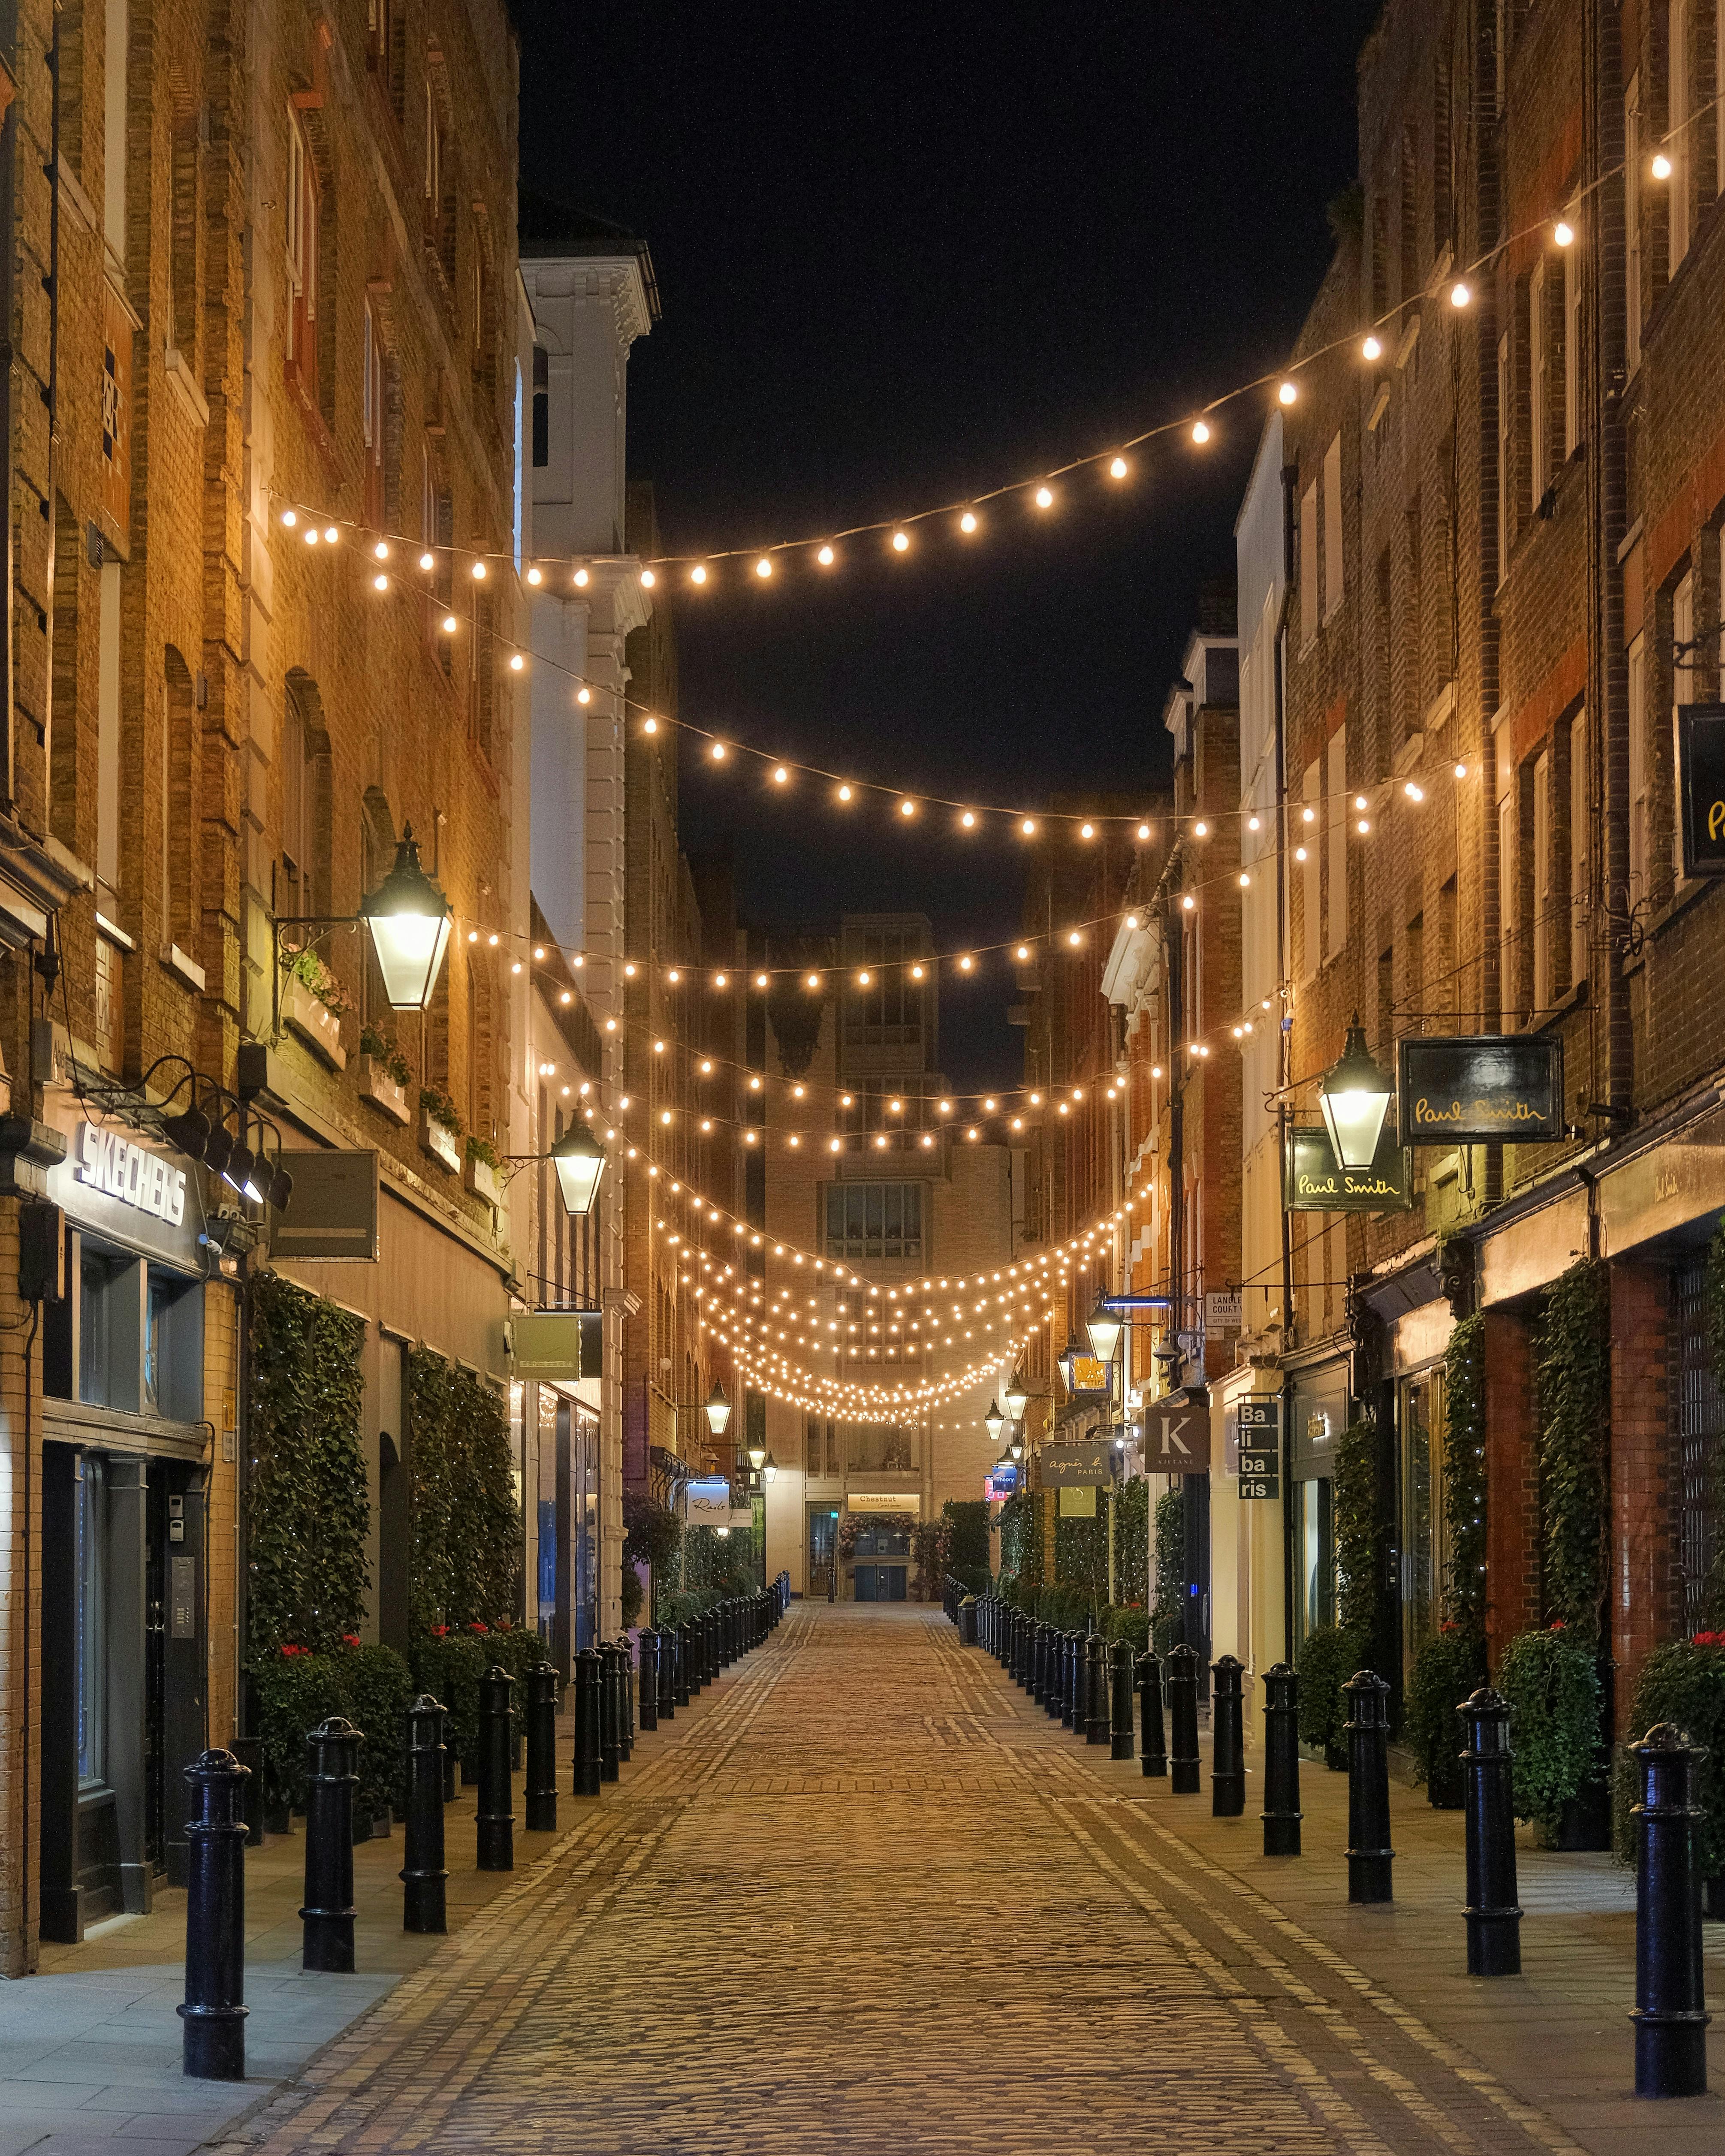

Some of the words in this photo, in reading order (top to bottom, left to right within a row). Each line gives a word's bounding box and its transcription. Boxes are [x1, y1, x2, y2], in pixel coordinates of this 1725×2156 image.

[1708, 800, 1725, 841] P
[1416, 1098, 1466, 1123] Paul
[1475, 1100, 1547, 1120] Smith
[81, 1120, 187, 1226] SKECHERS
[1299, 1174, 1339, 1194] Paul
[1345, 1176, 1400, 1194] Smith
[1241, 1406, 1265, 1422] Ba
[1160, 1417, 1191, 1453] K
[1241, 1430, 1251, 1447] li
[1242, 1455, 1265, 1472] ba
[1242, 1480, 1266, 1496] ris
[692, 1498, 725, 1512] Rails
